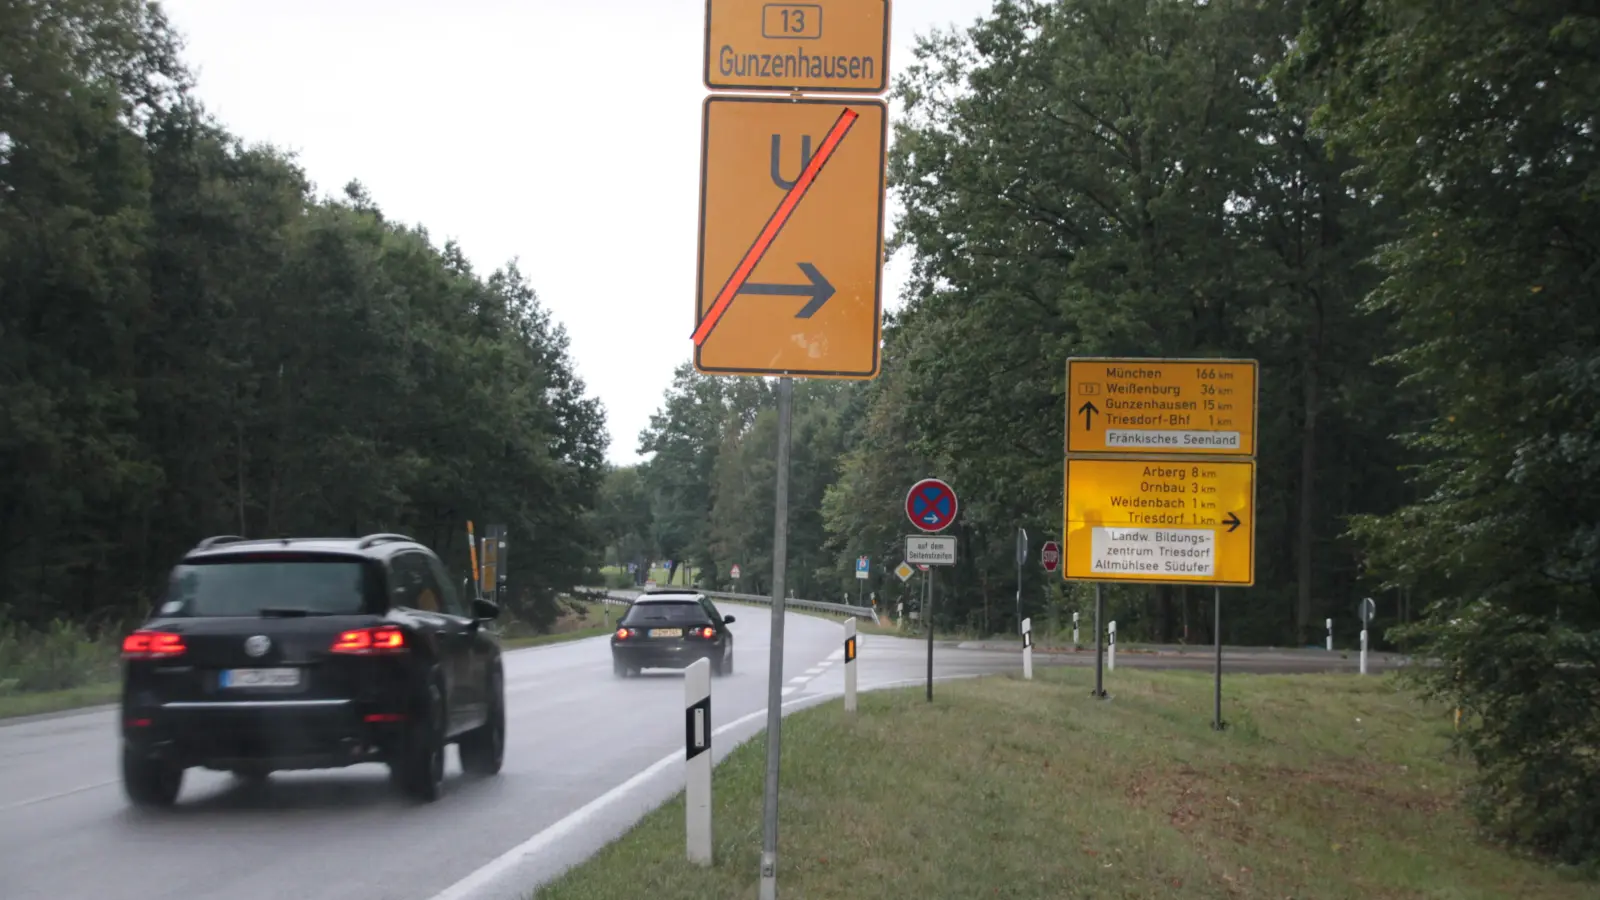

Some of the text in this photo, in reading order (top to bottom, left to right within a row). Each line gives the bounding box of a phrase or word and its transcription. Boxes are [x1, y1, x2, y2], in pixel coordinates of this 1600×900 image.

[781, 10, 805, 33] 13
[720, 45, 874, 79] Gunzenhausen
[1106, 368, 1234, 380] München 166 km
[1084, 385, 1094, 393] 13
[1106, 383, 1233, 397] Weißenburg 36 km
[1105, 399, 1233, 411] Gunzenhausen 15 km
[1105, 413, 1232, 426] Triesdorf-Bhf 1 km
[1109, 432, 1237, 445] Fränkisches Seenland
[1142, 466, 1217, 480] Arberg 8 km
[1140, 481, 1216, 493] Ornbau 3 km
[1110, 496, 1216, 508] Weidenbach 1 km
[1128, 512, 1216, 525] Triesdorf 1 km
[1111, 531, 1212, 545] Landw. Bildungs-
[917, 542, 944, 550] auf dem
[1107, 546, 1210, 557] zentrum Triesdorf
[909, 551, 953, 560] Seitenstreifen
[1044, 551, 1058, 562] STOP
[1095, 560, 1210, 572] Altmühlsee Südufer
